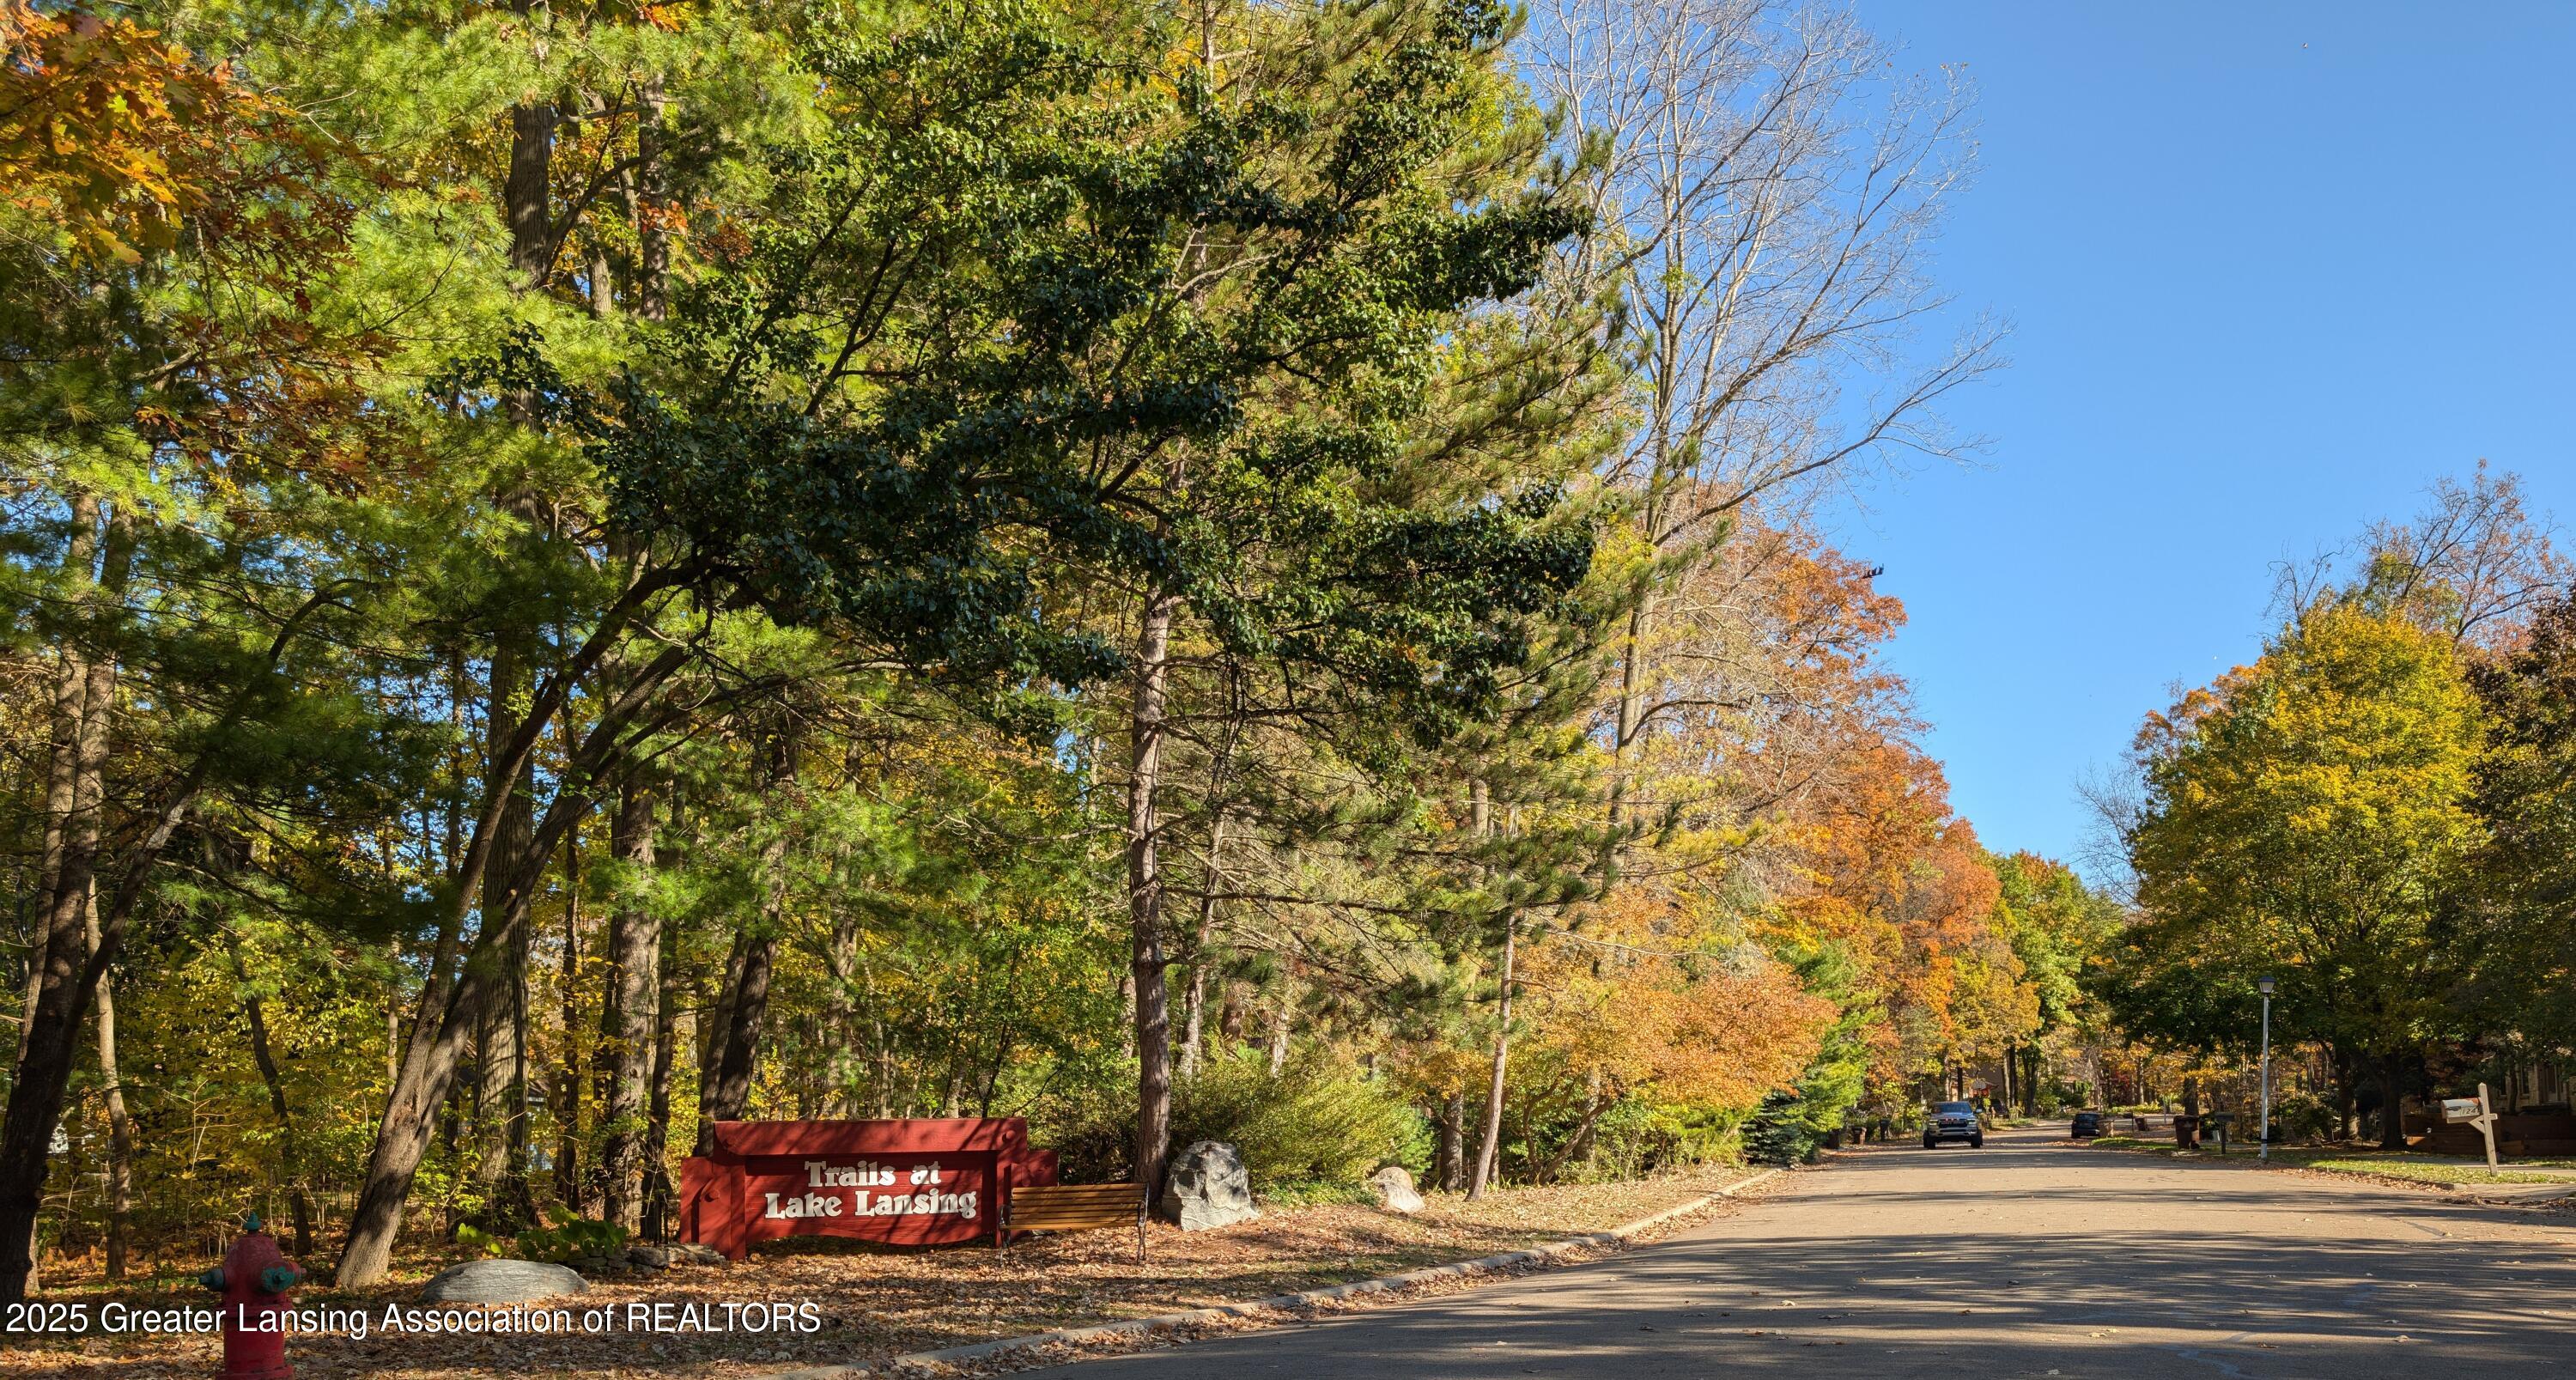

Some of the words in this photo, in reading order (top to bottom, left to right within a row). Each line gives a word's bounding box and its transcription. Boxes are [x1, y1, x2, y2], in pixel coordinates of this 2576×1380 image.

[804, 1159, 896, 1188] Trails
[909, 1160, 942, 1186] at
[764, 1191, 842, 1219] Lake
[854, 1188, 977, 1219] Lansing
